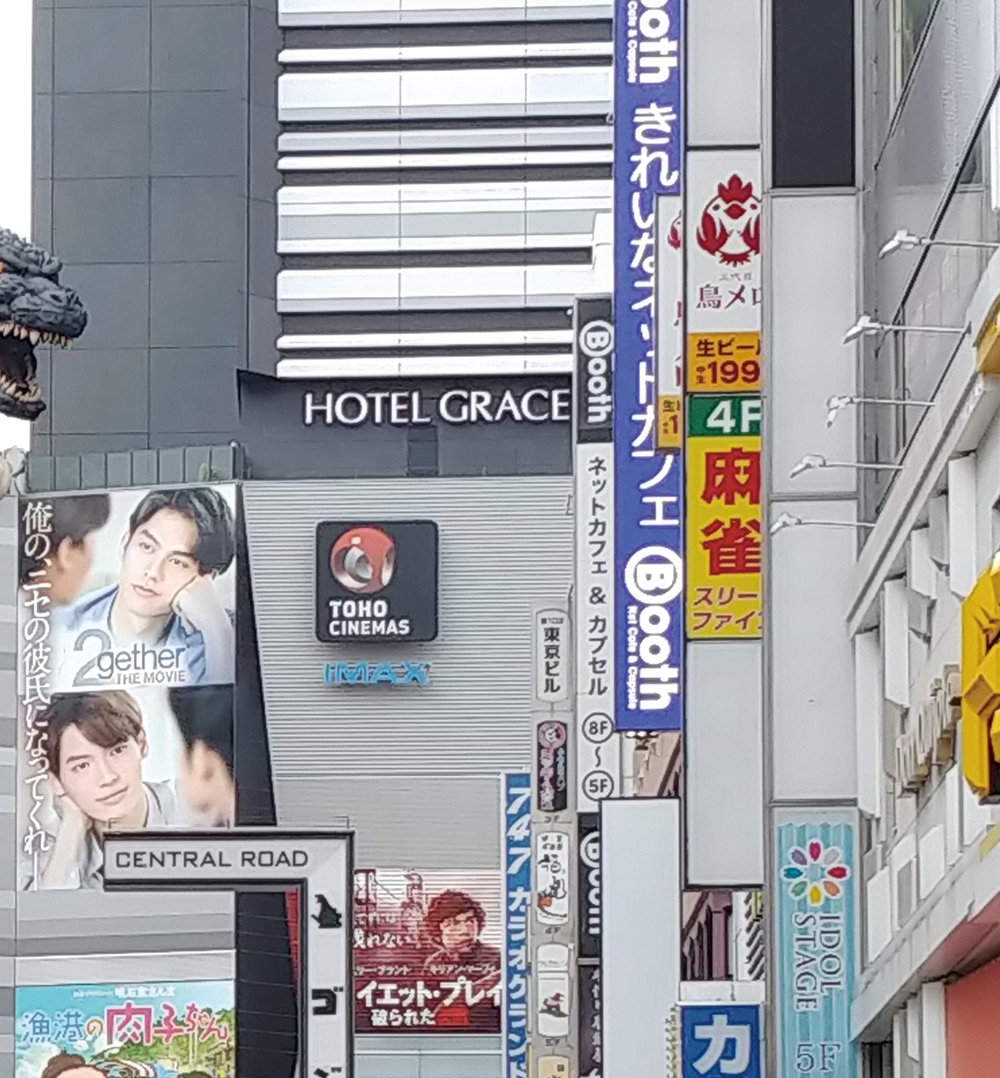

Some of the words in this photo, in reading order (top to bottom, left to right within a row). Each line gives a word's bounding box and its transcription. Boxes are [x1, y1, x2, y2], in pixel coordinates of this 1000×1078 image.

[708, 360, 760, 384] 199
[304, 391, 432, 424] HOTEL
[706, 400, 760, 433] 4F
[587, 457, 608, 575] ネットカフェ
[701, 448, 760, 577] 麻雀
[329, 600, 388, 618] TOHO
[589, 587, 606, 605] &
[328, 619, 411, 636] CINEMAS
[72, 628, 187, 688] 2gether
[543, 626, 561, 694] 東京ビル
[587, 614, 608, 697] カプセル
[115, 672, 141, 686] THE
[143, 671, 187, 685] MOVIE
[323, 663, 431, 684] IMAX
[588, 722, 608, 735] 8F
[588, 779, 608, 793] 5F
[115, 850, 232, 868] CENTRAL
[241, 850, 309, 867] ROAD
[793, 914, 818, 1012] STAGE
[819, 914, 842, 995] IDOL
[22, 1001, 230, 1046] 漁港の肉子ちゃん
[370, 1009, 437, 1027] 破られた
[796, 1043, 842, 1072] 5F
